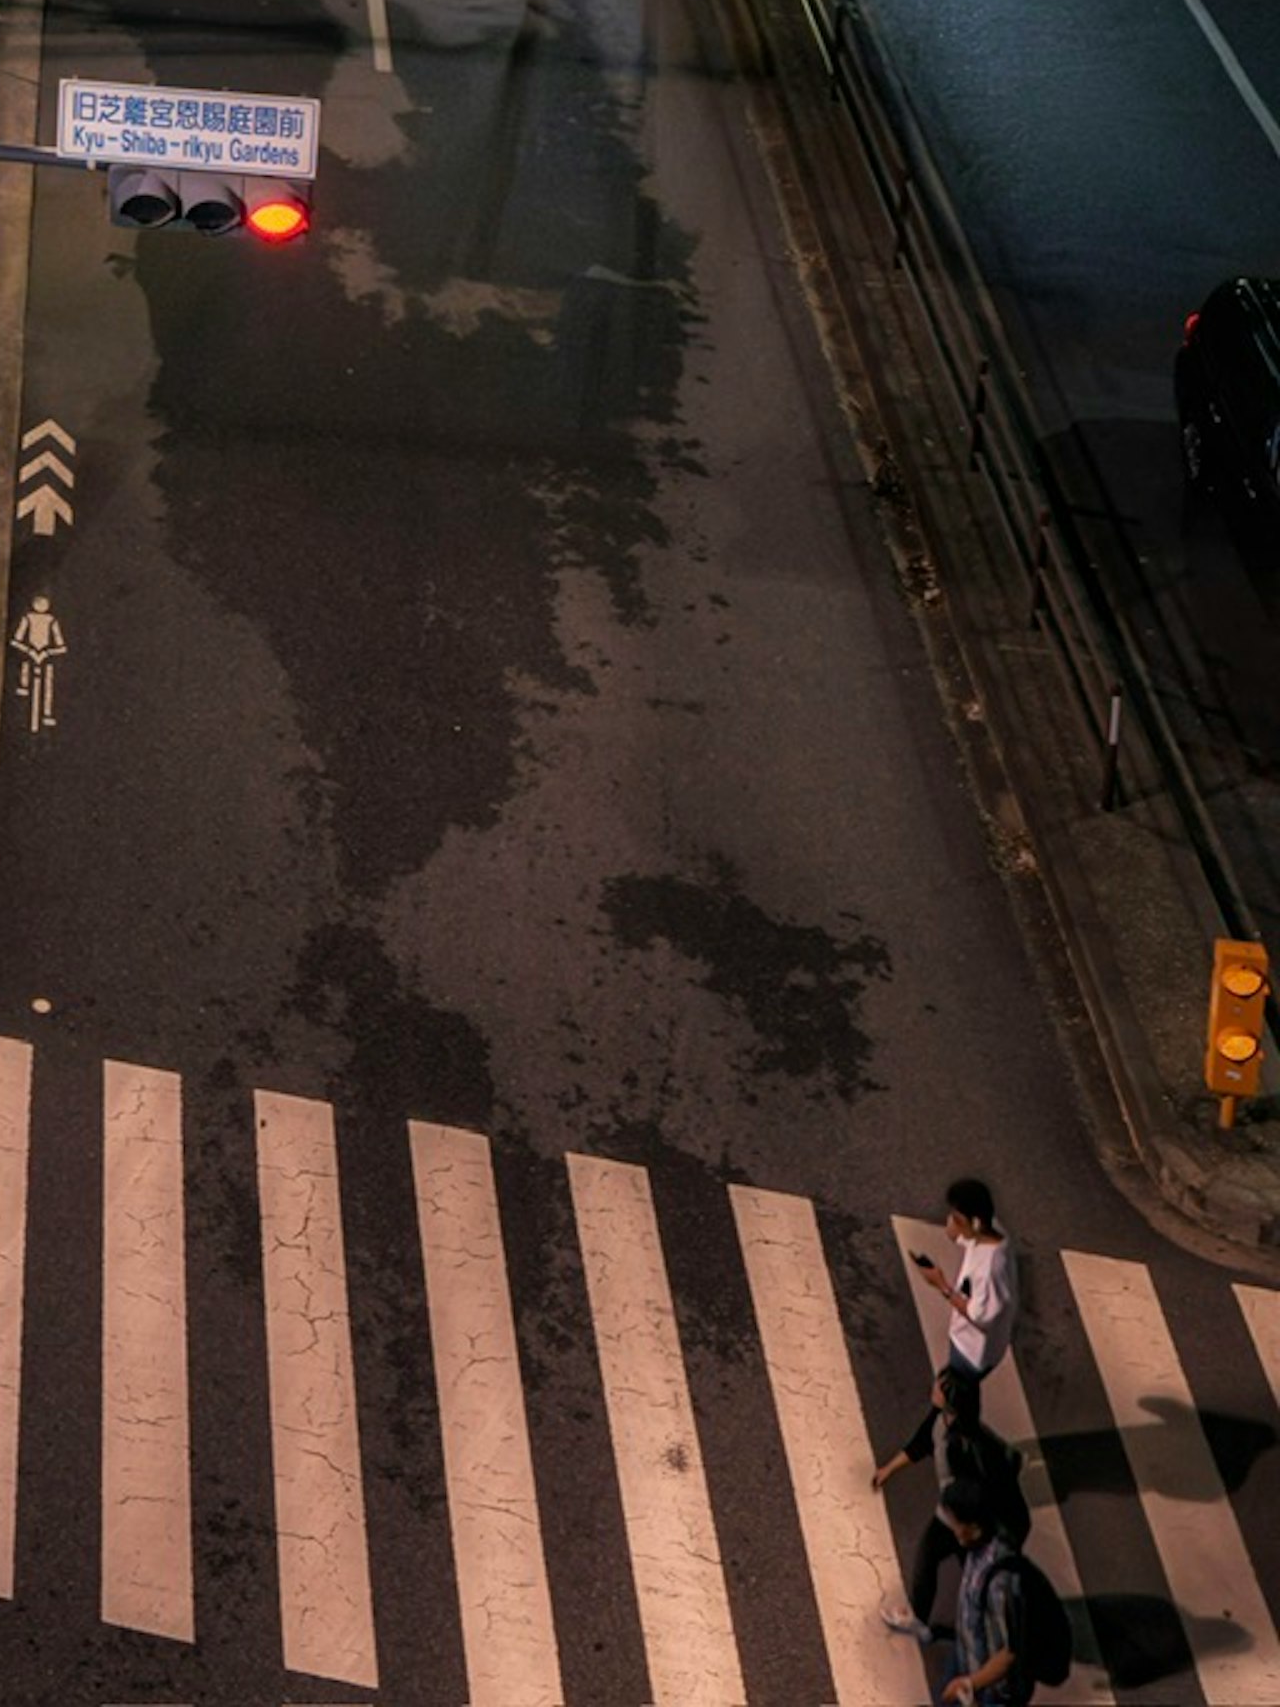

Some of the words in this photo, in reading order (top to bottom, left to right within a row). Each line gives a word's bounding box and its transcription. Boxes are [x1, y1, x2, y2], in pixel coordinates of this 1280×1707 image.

[72, 91, 305, 139] 旧芝離宮恩賜庭園前
[229, 137, 300, 167] Gardens
